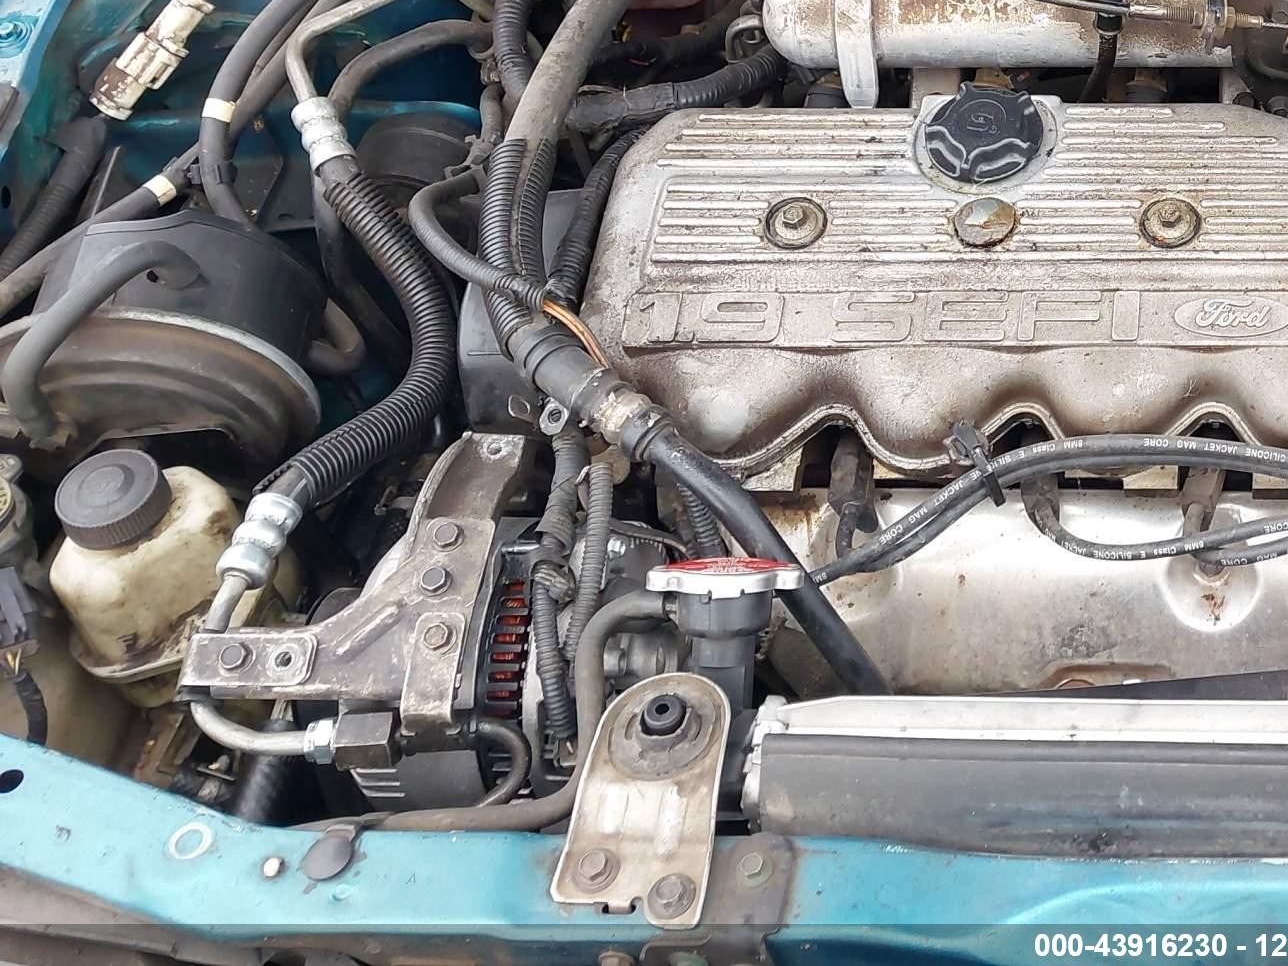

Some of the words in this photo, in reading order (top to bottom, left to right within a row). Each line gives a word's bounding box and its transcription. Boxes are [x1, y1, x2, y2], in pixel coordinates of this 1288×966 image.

[640, 293, 786, 343] 1.9
[831, 290, 1141, 342] SEFI
[1195, 297, 1272, 328] Ford
[1143, 437, 1169, 447] CORE
[1176, 440, 1197, 449] MAG
[1031, 443, 1056, 453] Class
[1203, 442, 1239, 455] JACKET
[1018, 450, 1025, 459] E
[933, 480, 964, 507] JACKET
[908, 507, 928, 524] MAG
[878, 524, 905, 545] CORE
[1092, 549, 1133, 559] SILICONE
[1139, 550, 1146, 559] E
[1153, 546, 1177, 555] Class
